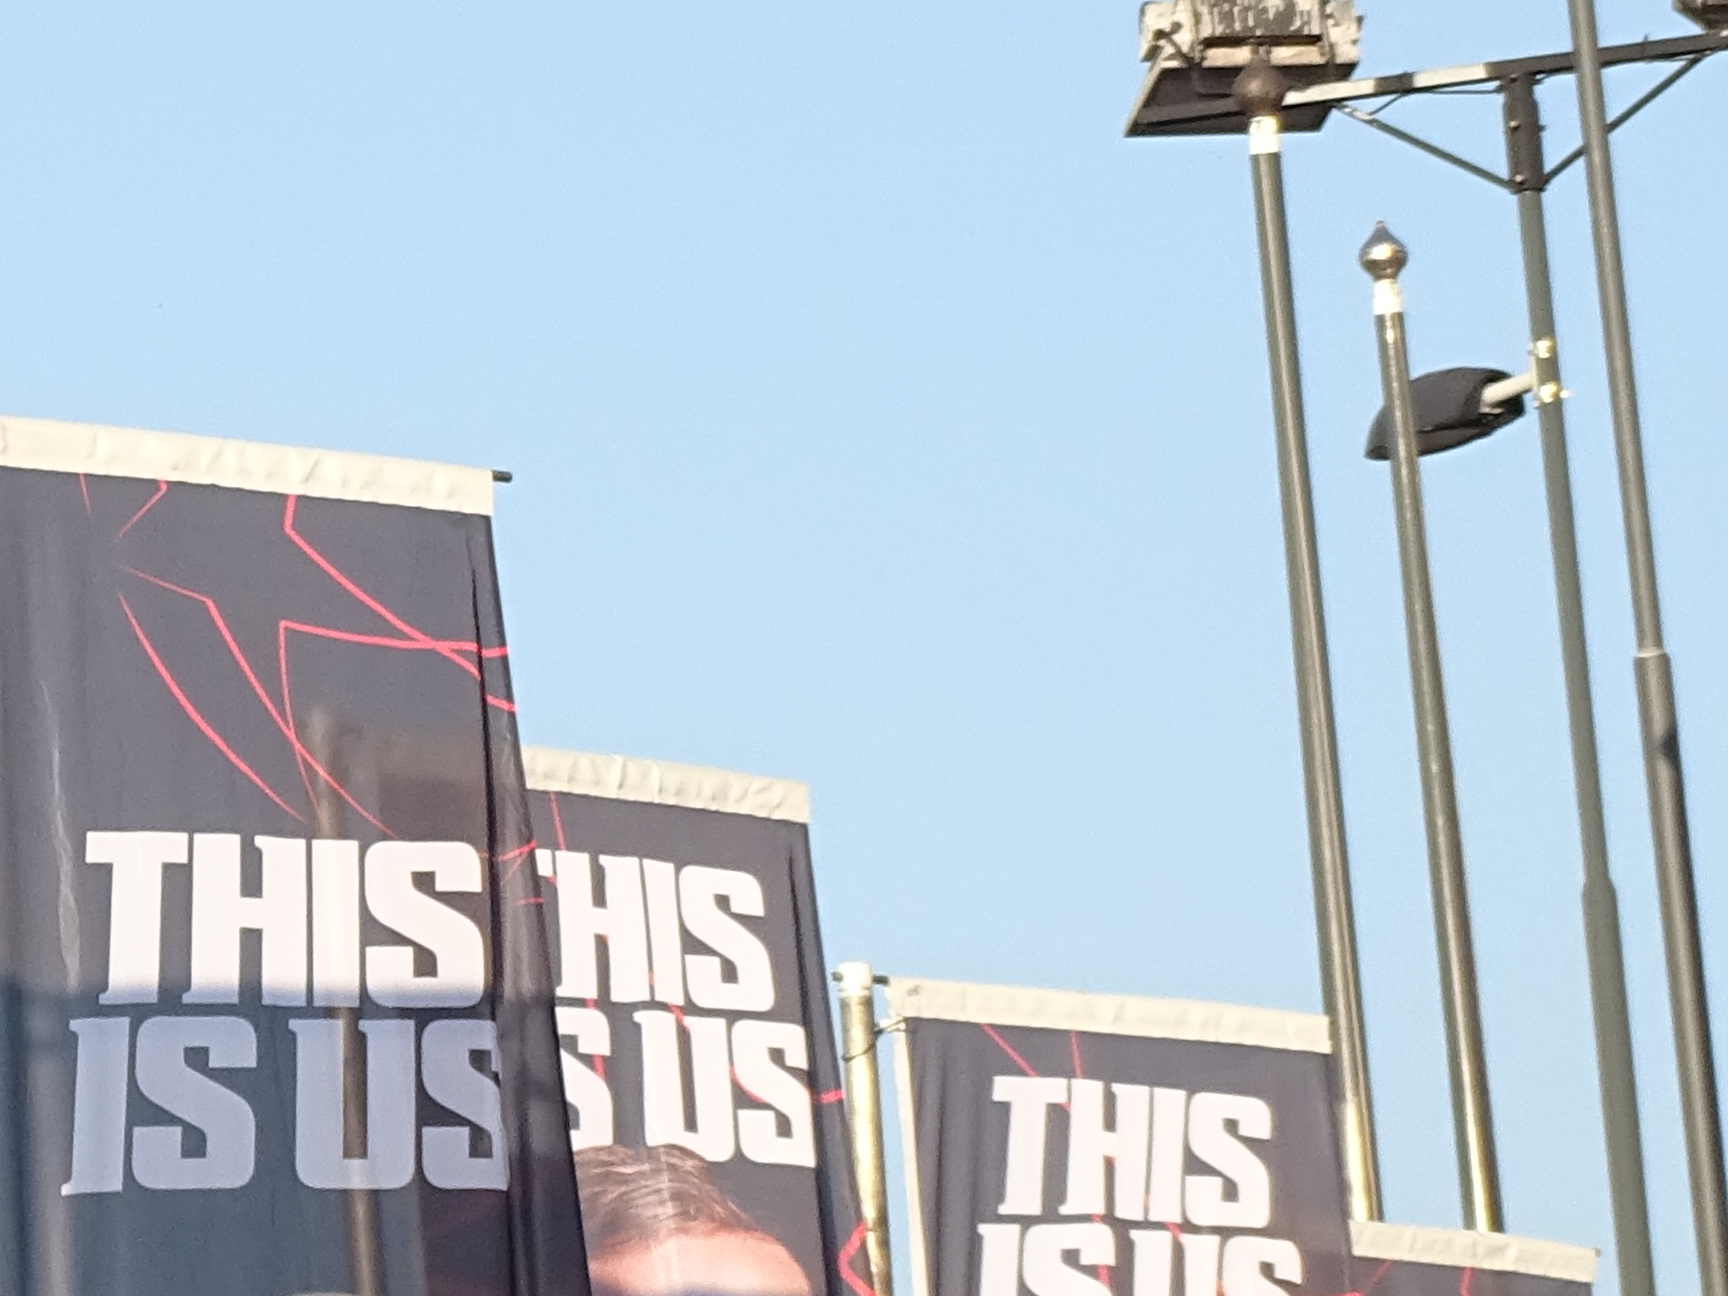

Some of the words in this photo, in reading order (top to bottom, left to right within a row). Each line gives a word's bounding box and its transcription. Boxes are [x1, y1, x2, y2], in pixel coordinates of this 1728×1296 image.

[85, 830, 484, 1008] THIS
[537, 849, 776, 1012] HIS
[61, 1015, 257, 1196] IS
[288, 1016, 510, 1192] US
[634, 1008, 817, 1168] US
[992, 1075, 1272, 1229] THIS
